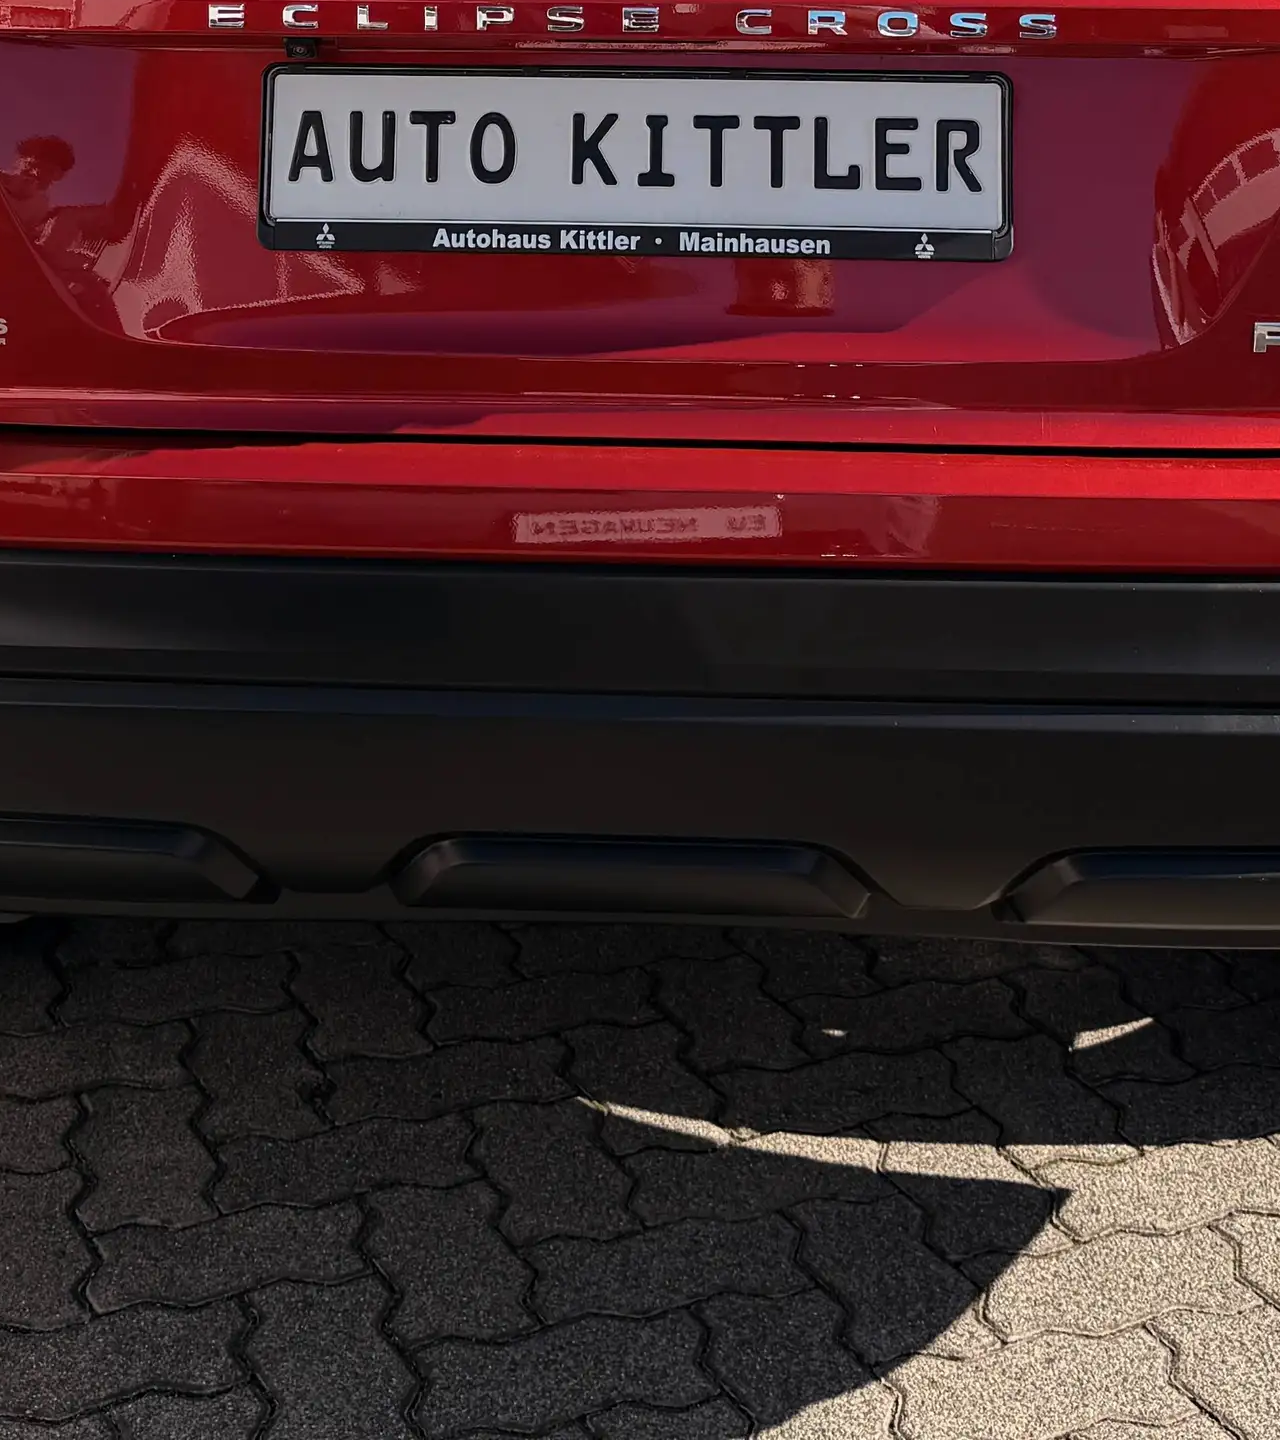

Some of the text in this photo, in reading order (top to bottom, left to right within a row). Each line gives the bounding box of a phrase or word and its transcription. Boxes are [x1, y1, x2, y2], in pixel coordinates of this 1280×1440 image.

[208, 4, 1059, 40] ECLIPSE CROSS
[287, 109, 985, 193] AUTO KITTLER
[432, 227, 832, 256] Autohaus Kittler Mainhausen
